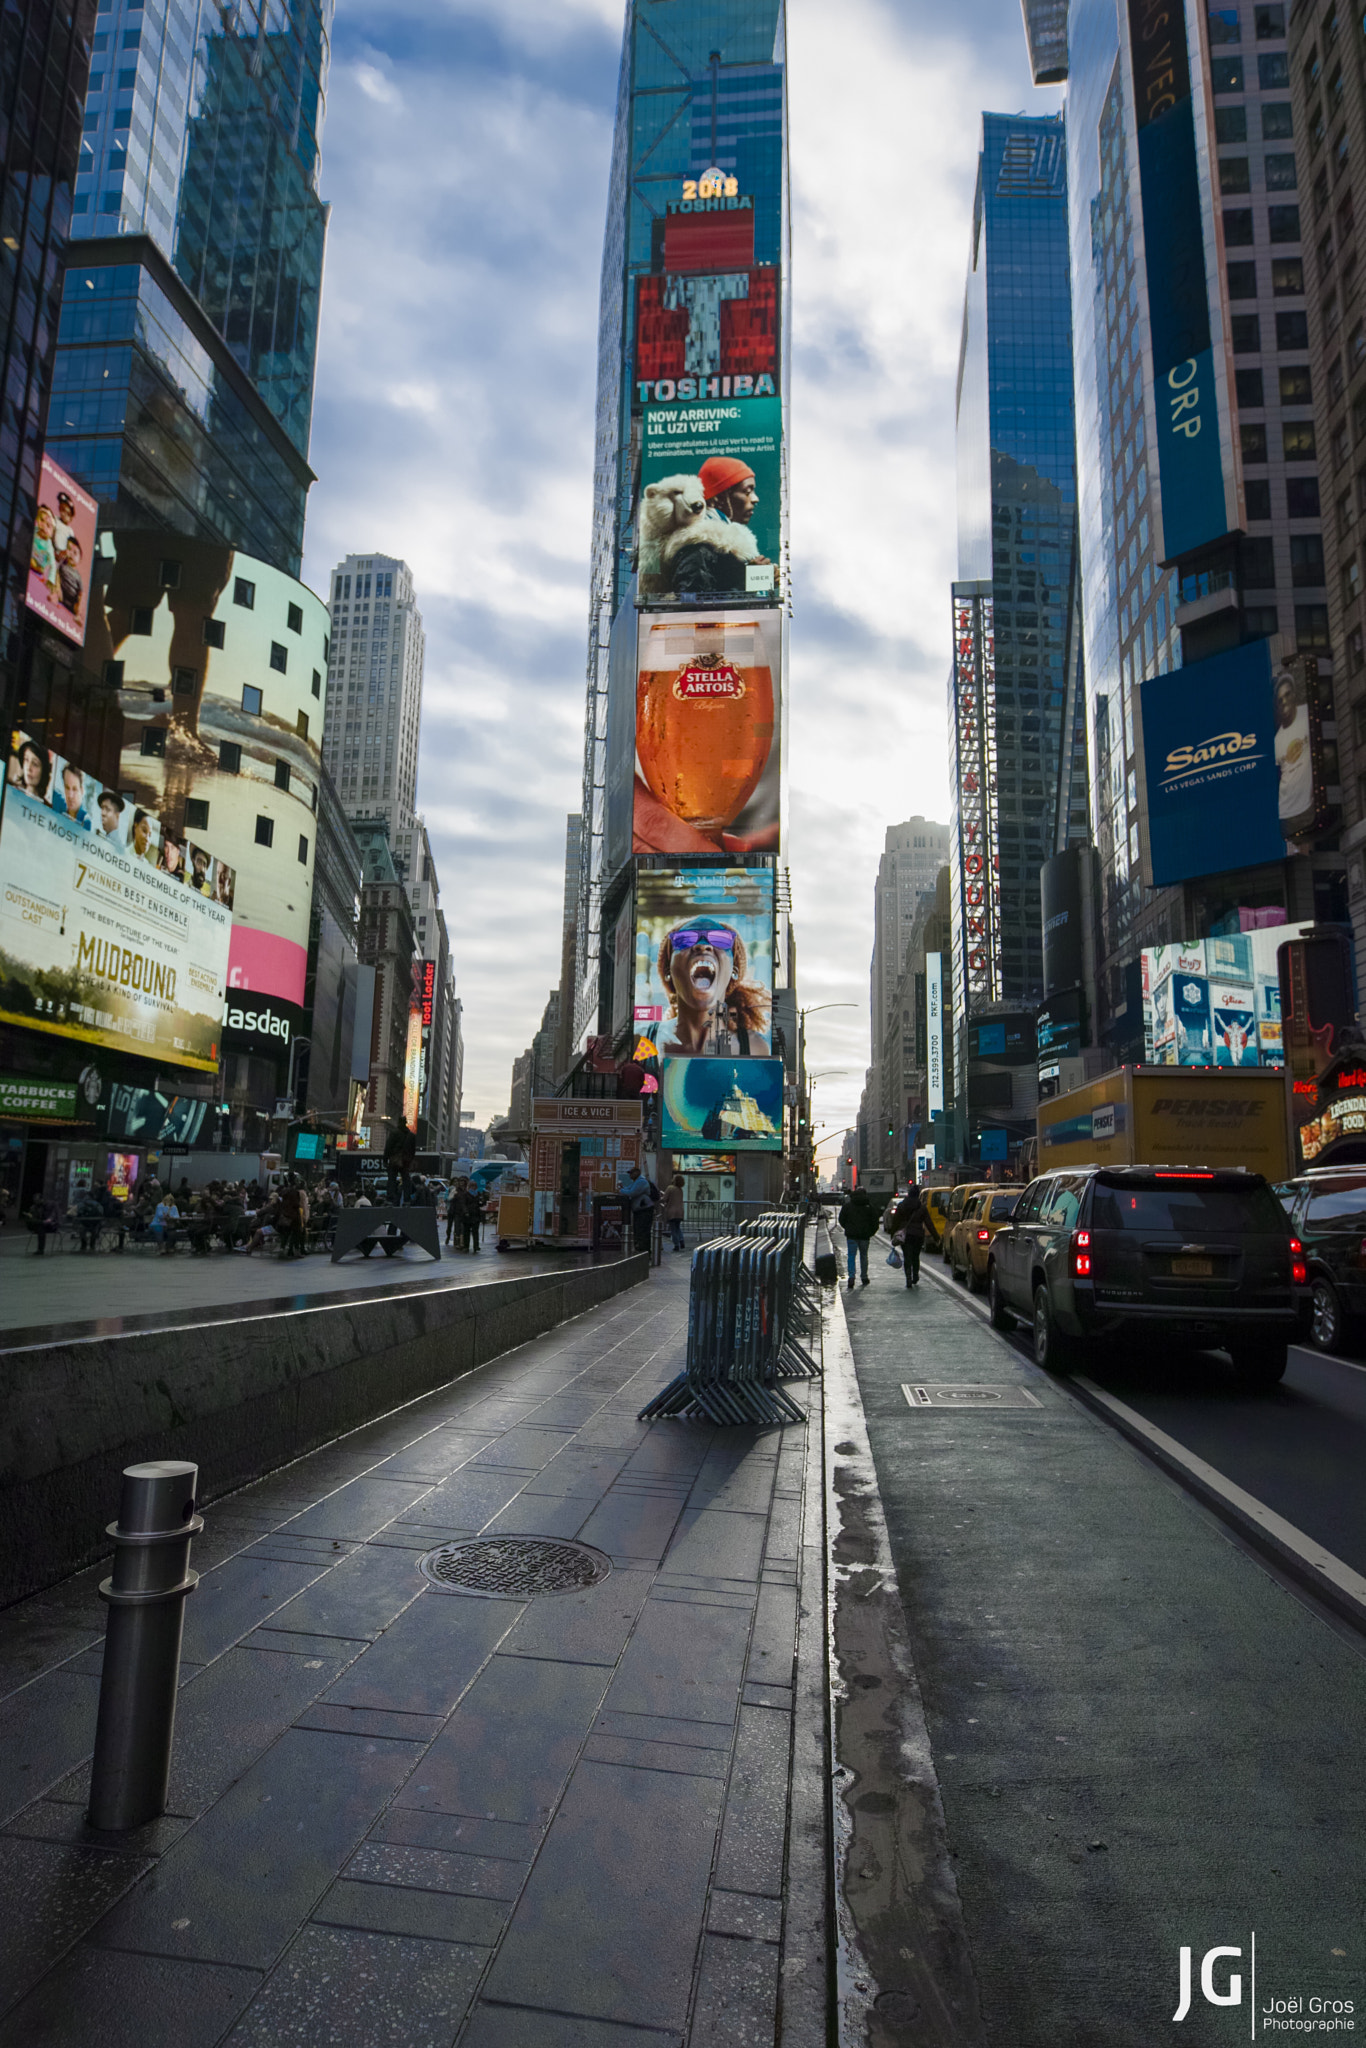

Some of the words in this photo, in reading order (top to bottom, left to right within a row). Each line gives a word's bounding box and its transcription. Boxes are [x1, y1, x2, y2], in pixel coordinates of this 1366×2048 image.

[682, 177, 738, 200] 2018
[668, 196, 752, 215] TOSHIBA
[637, 373, 776, 402] TOSHIBA
[647, 411, 678, 422] NOW
[679, 407, 741, 421] ARRIVING:
[647, 423, 665, 435] LIL
[667, 422, 687, 434] UZI
[690, 420, 721, 432] VERT
[647, 450, 653, 458] 2
[653, 448, 695, 457] nominations,
[695, 446, 725, 456] including
[726, 445, 741, 453] Best
[741, 445, 756, 453] New
[756, 444, 776, 452] Artist
[648, 441, 664, 450] Uber
[664, 440, 709, 451] congratulates
[709, 438, 718, 447] Lil
[718, 437, 729, 446] Uzi
[750, 436, 765, 444] road
[750, 574, 770, 582] UBER
[686, 672, 733, 683] STELLA
[960, 609, 974, 740] ERNST
[685, 682, 735, 694] ARTOIS
[1163, 732, 1257, 772] Sands
[1164, 784, 1179, 793] LAS
[1180, 777, 1205, 790] VEGAS
[1206, 769, 1233, 782] SANDS
[1234, 761, 1258, 774] CORP
[21, 805, 45, 828] THE
[48, 820, 79, 845] MOST
[82, 839, 131, 873] HONORED
[133, 868, 179, 900] ENSEMBLE
[180, 892, 191, 903] OF
[192, 899, 207, 915] THE
[208, 907, 226, 925] YEAR
[87, 868, 122, 895] WINNER
[124, 887, 145, 904] BEST
[148, 899, 188, 927] ENSEMBLE
[966, 821, 986, 970] YOUNG
[5, 890, 60, 921] OUTSTANDING
[22, 910, 43, 926] CAST
[97, 914, 115, 928] BEST
[115, 920, 141, 938] PICTURE
[142, 934, 151, 942] OF
[152, 938, 162, 949] THE
[76, 930, 177, 1002] MUDBOUND
[188, 967, 200, 978] BEST
[200, 971, 217, 986] ACTING
[190, 978, 214, 994] ENSEMBLE
[422, 963, 434, 999] Locker
[113, 986, 131, 999] KIND
[133, 992, 142, 1002] OF
[144, 996, 174, 1014] SURVIVAL
[931, 1034, 939, 1088] 212.599.3700
[2, 1096, 57, 1109] COFFEE
[564, 1106, 578, 1116] ICE
[581, 1106, 588, 1116] &
[590, 1107, 611, 1117] VICE
[1151, 1098, 1267, 1116] PENSKE
[1093, 1114, 1114, 1130] PENSKE
[1342, 1114, 1365, 1131] FOOD
[361, 1158, 380, 1170] PDS
